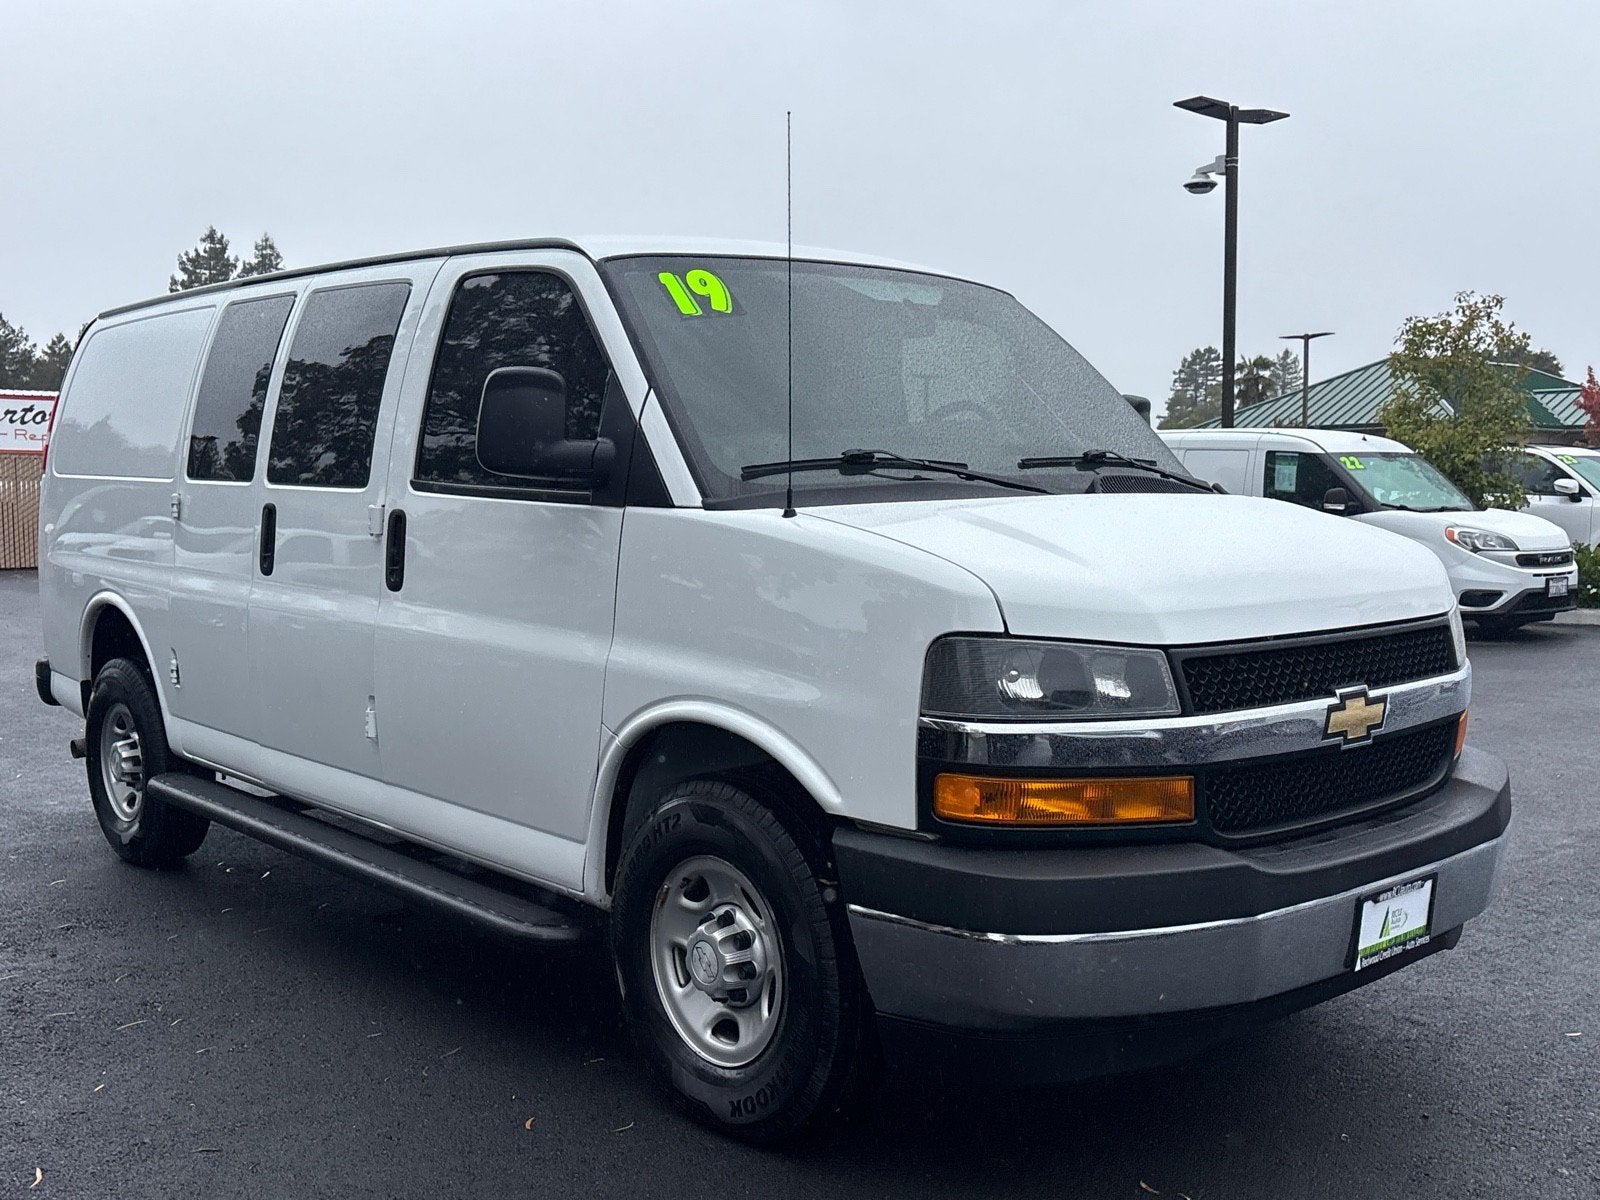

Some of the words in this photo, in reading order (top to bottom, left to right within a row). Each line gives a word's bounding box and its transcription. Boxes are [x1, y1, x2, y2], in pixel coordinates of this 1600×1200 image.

[658, 269, 733, 316] 19
[0, 404, 52, 426] rto
[1339, 455, 1365, 470] 22
[1539, 556, 1562, 565] RAM
